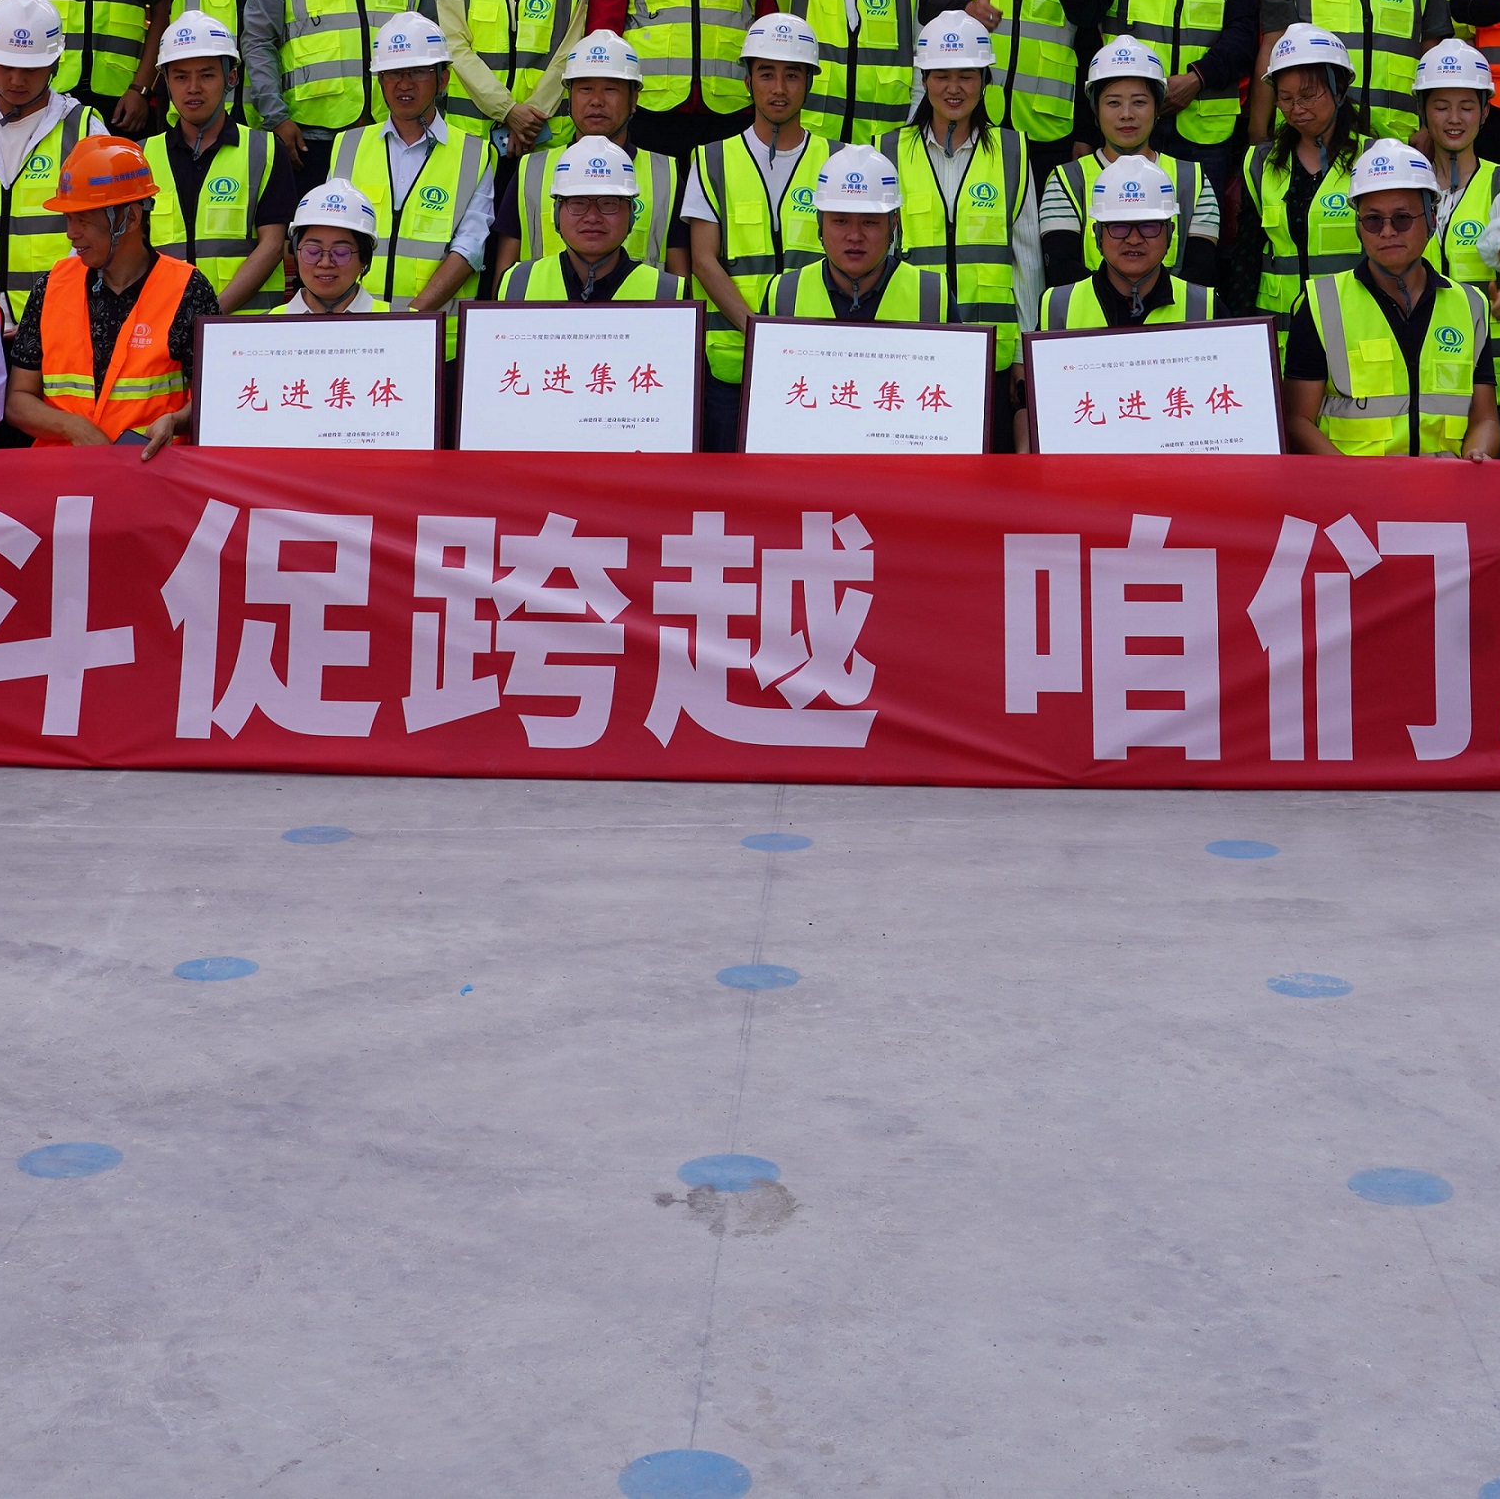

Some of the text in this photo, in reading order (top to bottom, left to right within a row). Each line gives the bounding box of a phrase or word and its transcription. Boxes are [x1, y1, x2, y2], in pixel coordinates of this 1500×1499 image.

[523, 11, 547, 19] YCIH
[420, 202, 444, 211] YCIH
[238, 377, 404, 412] 先进集体
[499, 361, 664, 396] 先进集体
[786, 375, 953, 413] 先进集体
[1073, 383, 1243, 426] 先进集体
